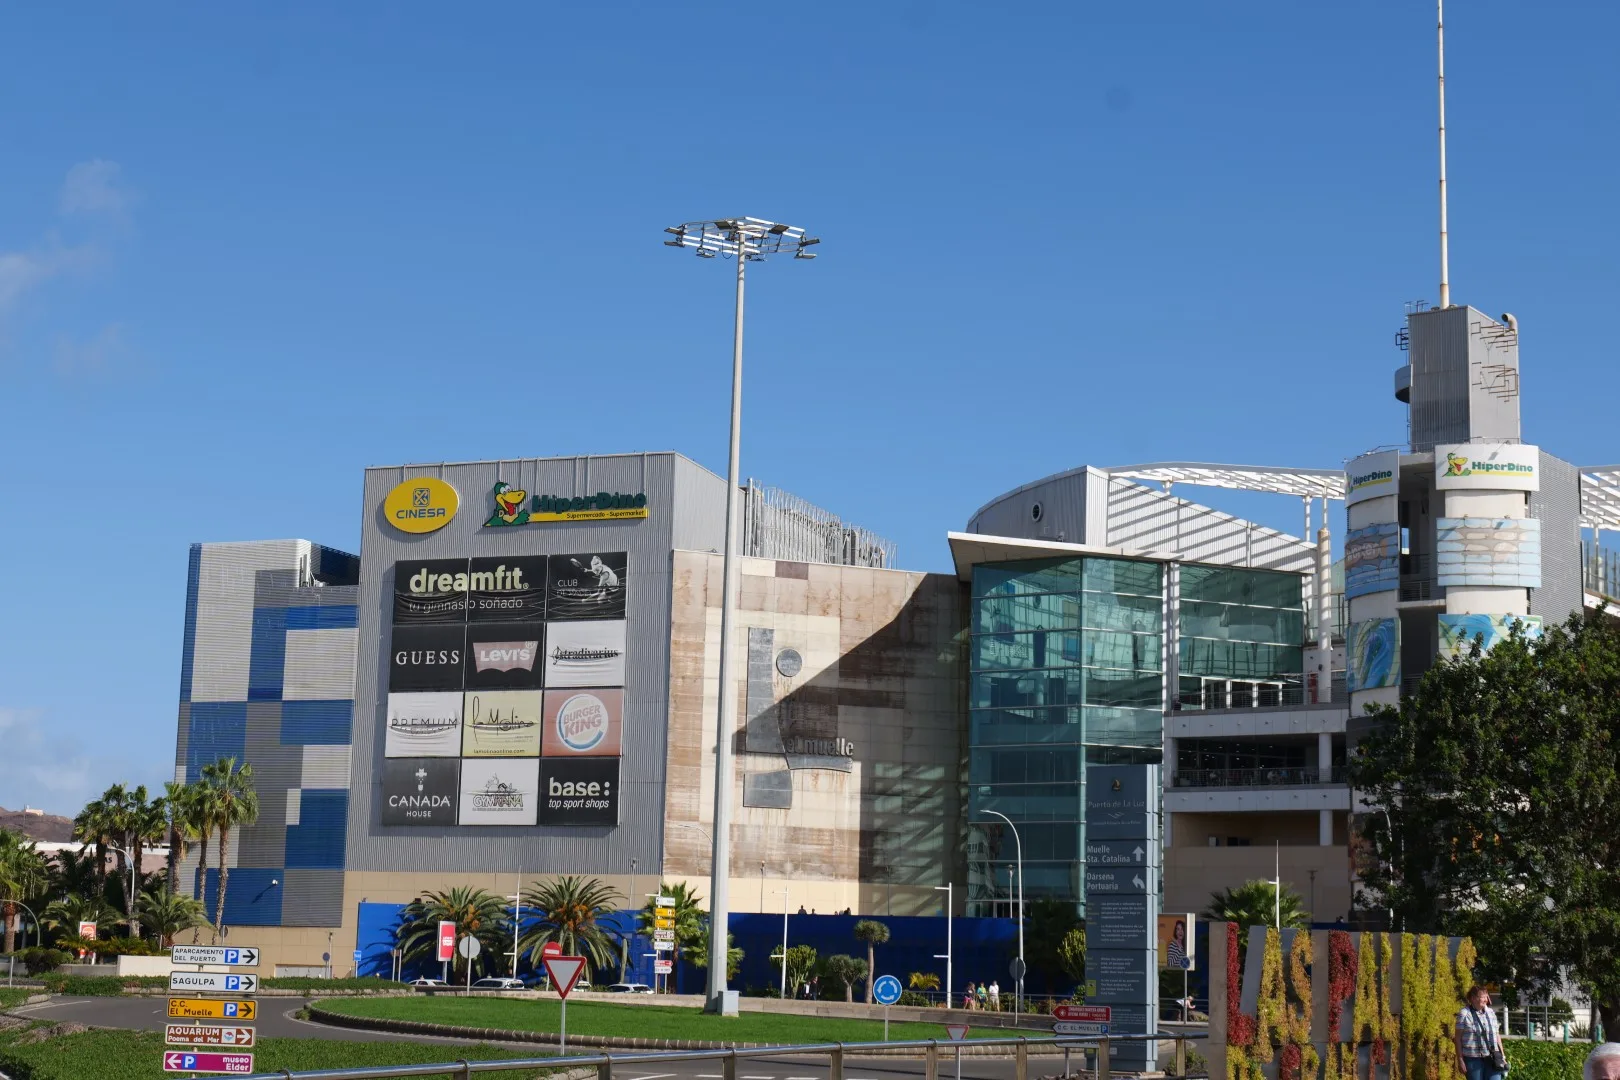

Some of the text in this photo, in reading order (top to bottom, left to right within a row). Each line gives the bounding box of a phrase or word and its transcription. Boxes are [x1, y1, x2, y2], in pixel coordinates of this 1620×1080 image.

[1471, 461, 1533, 472] HiperDino
[1353, 470, 1393, 485] HiperDino
[531, 491, 647, 514] HiperDino
[396, 508, 446, 519] CINESA
[566, 511, 605, 519] Supermercado
[409, 564, 523, 593] dreamfit
[557, 579, 578, 587] CLUB
[479, 597, 523, 609] soñado
[395, 650, 460, 665] GUESS
[564, 704, 601, 725] BURGER
[564, 714, 602, 738] KING
[388, 795, 451, 808] CANADA
[548, 798, 609, 810] top sport shops
[1086, 845, 1110, 853] Muelle
[1086, 854, 1131, 863] Sta. Catalina
[1086, 882, 1119, 890] Portuaria
[172, 977, 215, 986] SAGULPA
[1226, 921, 1313, 1060] LAS
[183, 1008, 212, 1016] Muelle
[168, 1027, 220, 1036] AQUARIUM
[226, 1063, 249, 1071] Elder
